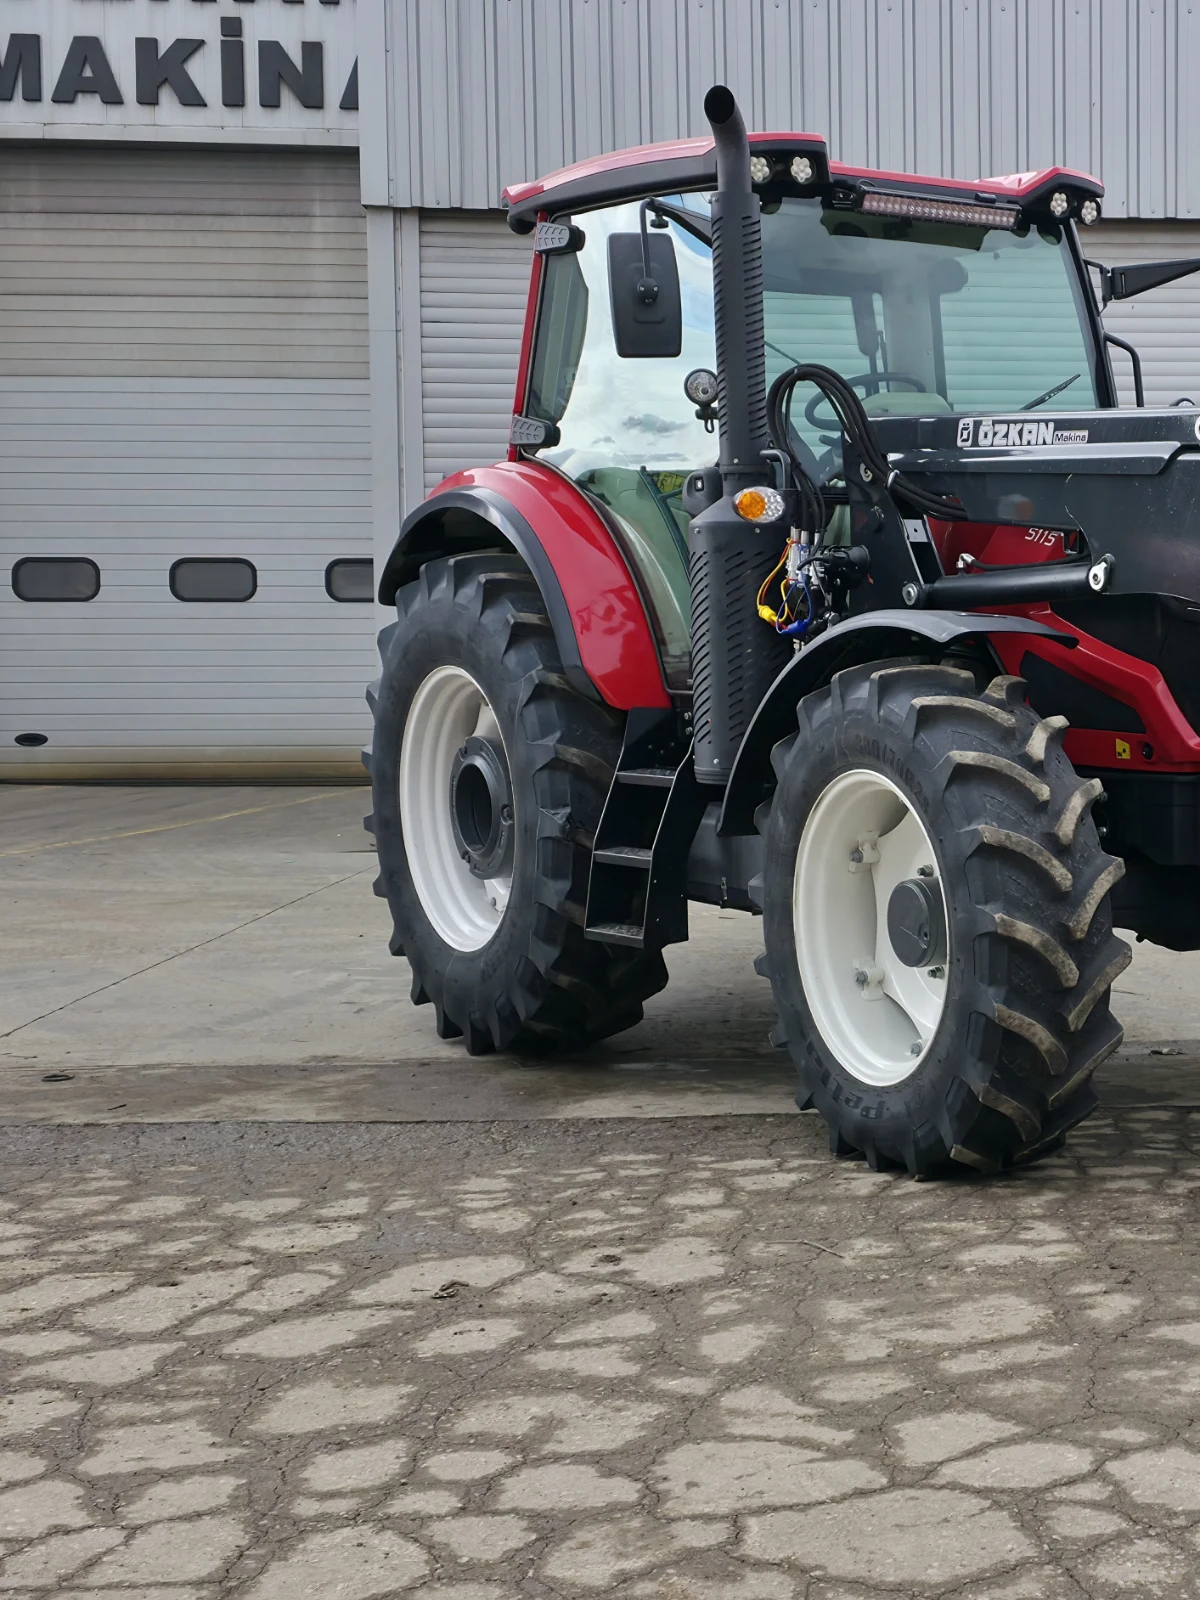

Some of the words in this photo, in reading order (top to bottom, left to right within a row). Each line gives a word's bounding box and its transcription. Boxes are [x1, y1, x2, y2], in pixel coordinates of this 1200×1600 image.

[0, 16, 358, 109] MAKİN
[978, 419, 1055, 446] ÖZKAN
[1054, 432, 1087, 442] Makina
[1025, 528, 1056, 546] 5115
